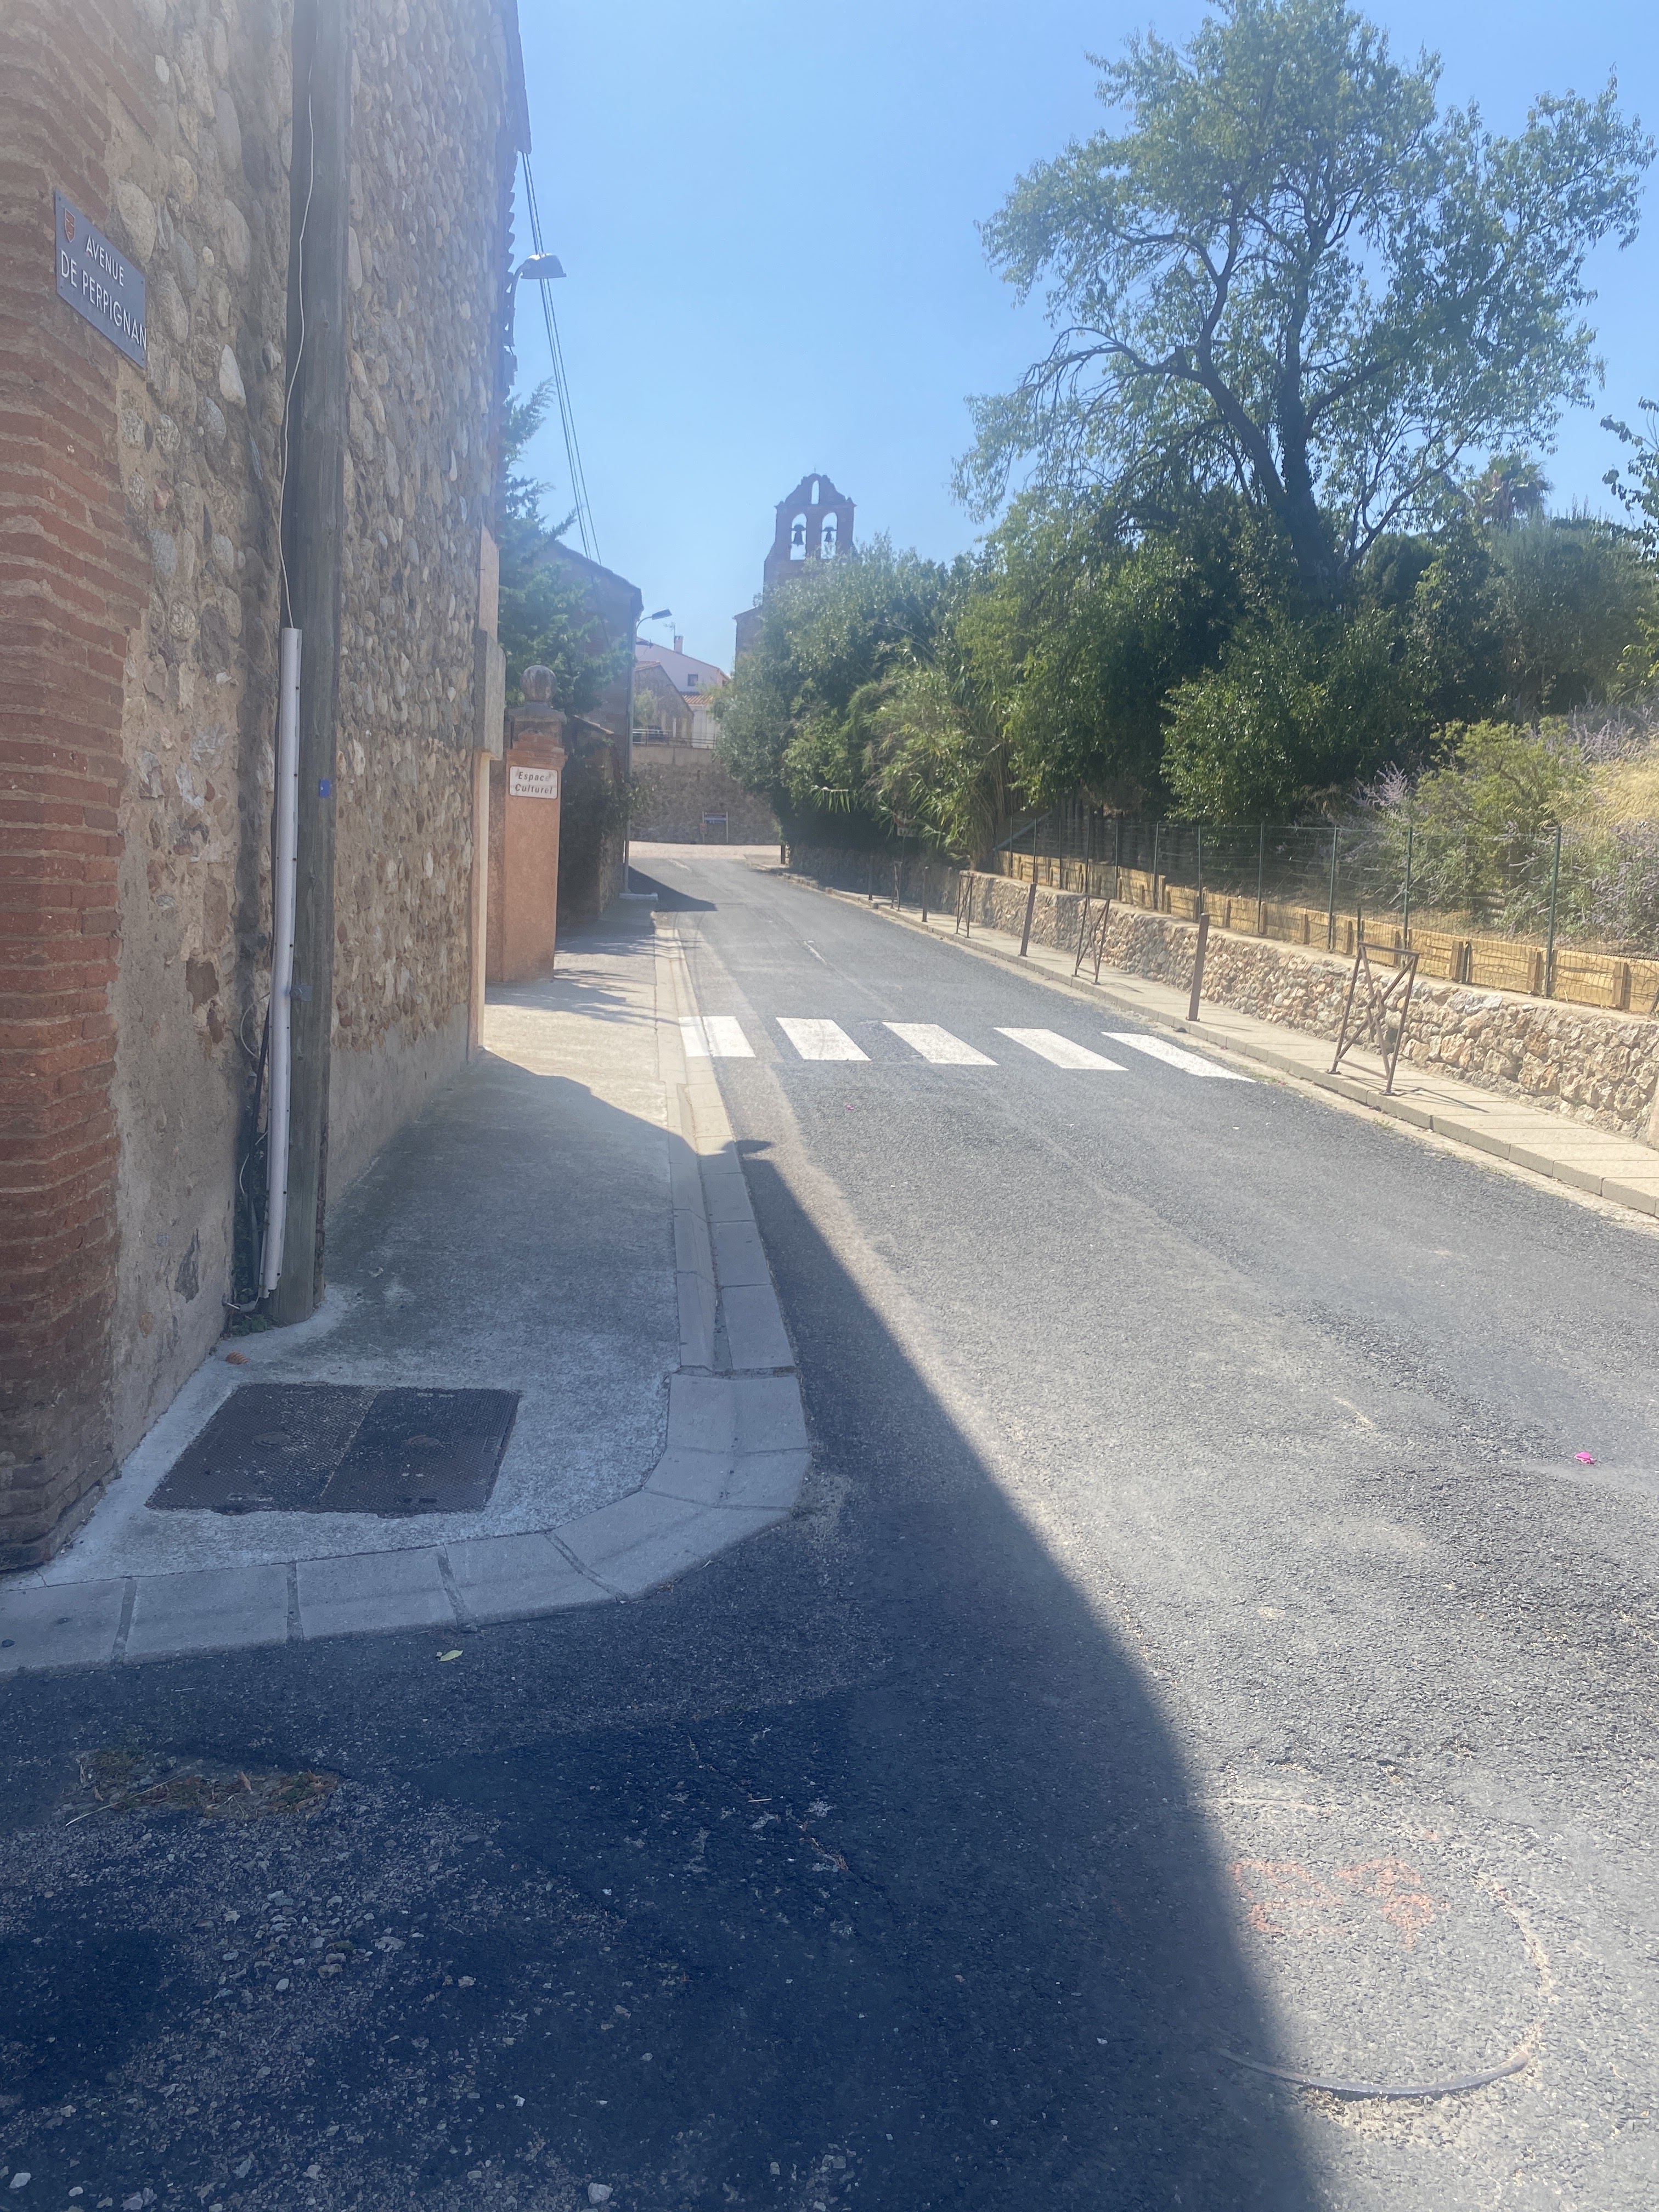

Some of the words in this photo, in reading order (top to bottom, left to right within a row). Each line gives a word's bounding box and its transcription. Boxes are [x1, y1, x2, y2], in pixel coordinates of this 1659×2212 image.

[86, 234, 124, 287] AVENUE
[61, 249, 77, 289] DE
[82, 269, 146, 351] PERPIGNAN
[515, 783, 553, 794] Culturel
